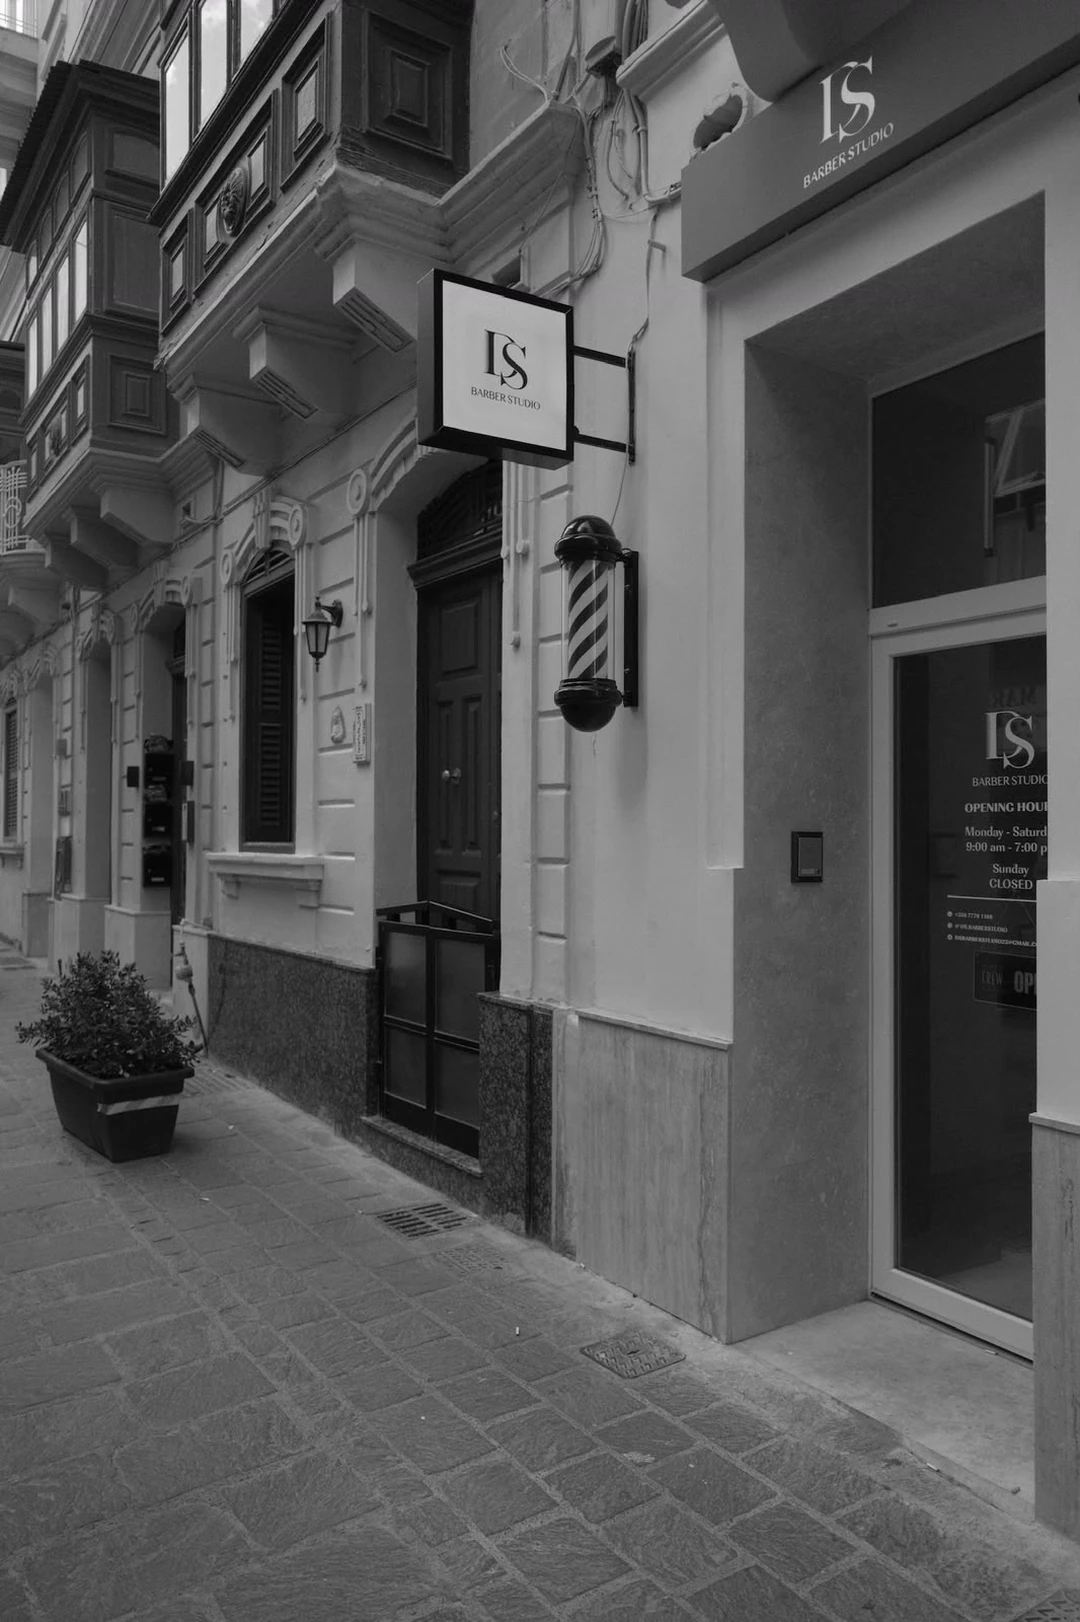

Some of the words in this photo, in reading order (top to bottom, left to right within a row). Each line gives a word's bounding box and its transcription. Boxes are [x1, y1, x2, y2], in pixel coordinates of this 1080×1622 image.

[803, 151, 846, 189] BARBER
[848, 122, 894, 161] STUDIO
[484, 329, 528, 391] DS
[471, 386, 507, 403] BARBER
[507, 395, 541, 410] STUDIO
[984, 710, 1035, 769] DS
[972, 776, 1010, 787] BARBER
[964, 802, 1014, 813] OPENING
[964, 826, 1004, 840] Monday
[966, 841, 988, 852] 9:00
[1014, 842, 1038, 852] 7:00
[992, 863, 1029, 878] Sunday
[989, 878, 1033, 890] CLOSED
